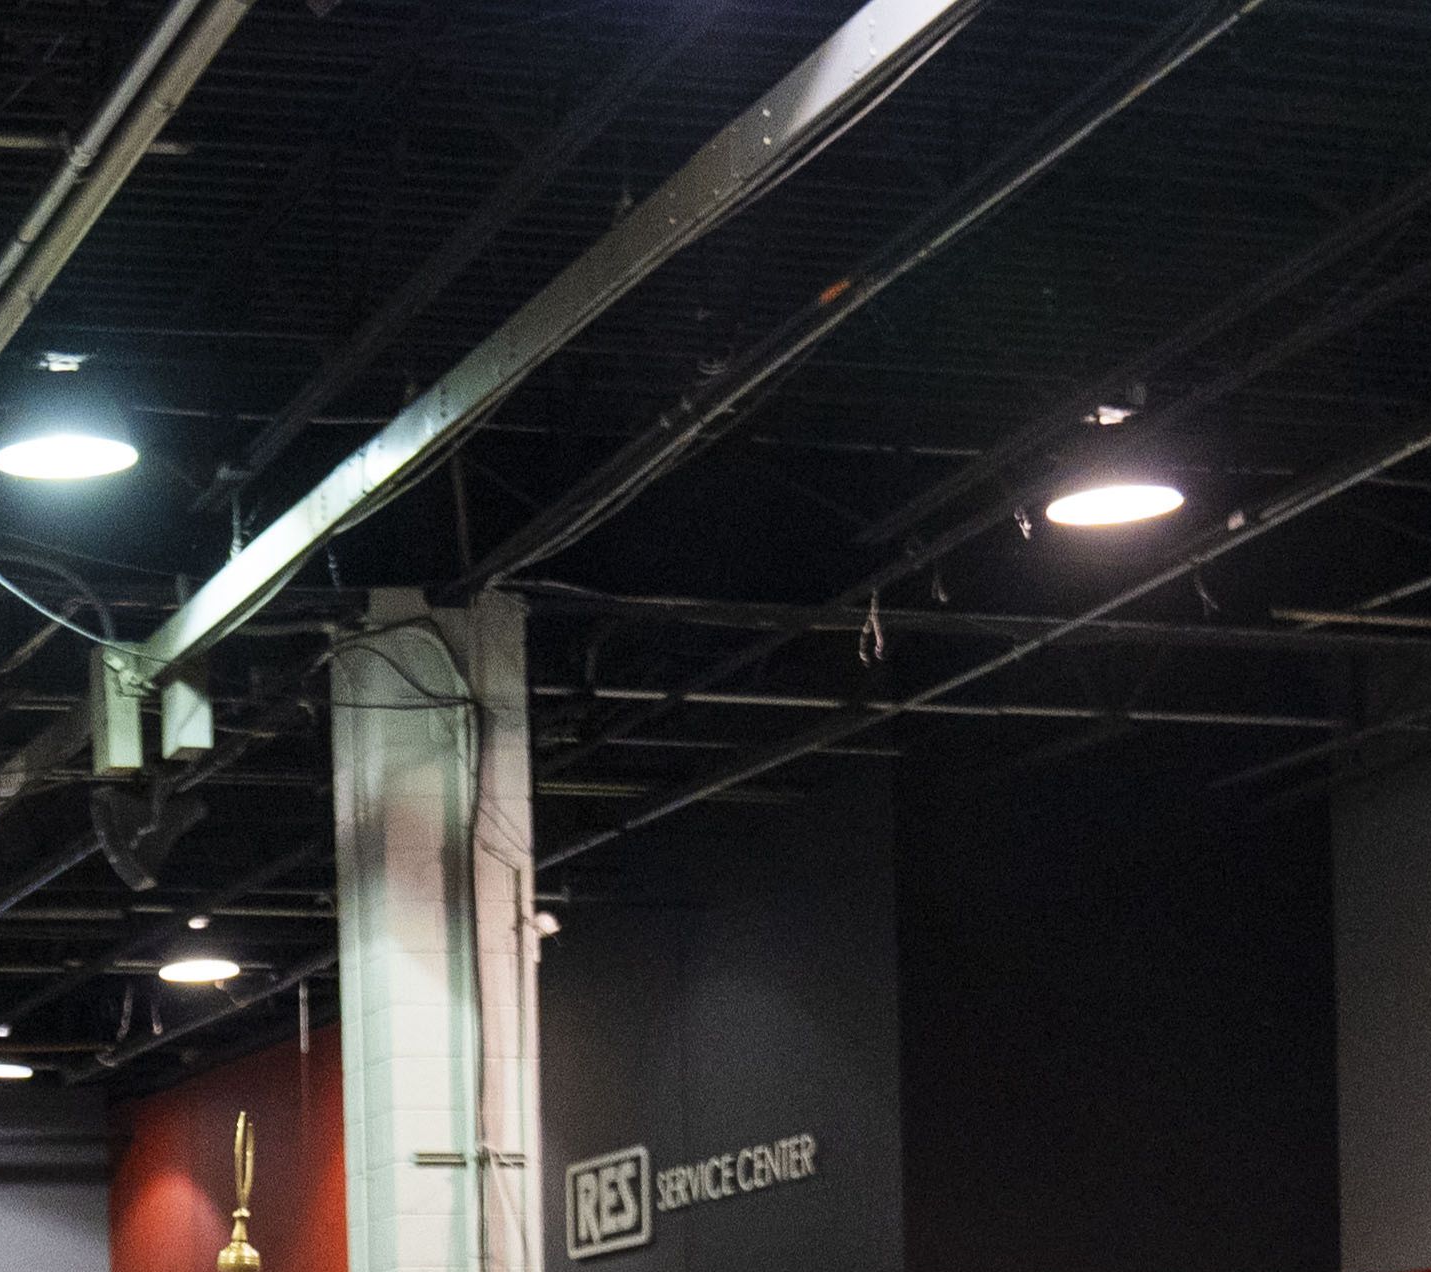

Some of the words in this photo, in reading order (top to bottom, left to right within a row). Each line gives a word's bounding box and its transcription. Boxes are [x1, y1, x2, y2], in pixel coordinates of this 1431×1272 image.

[576, 1162, 637, 1246] RES
[656, 1154, 737, 1212] SERVICE
[737, 1133, 817, 1192] CENTER
